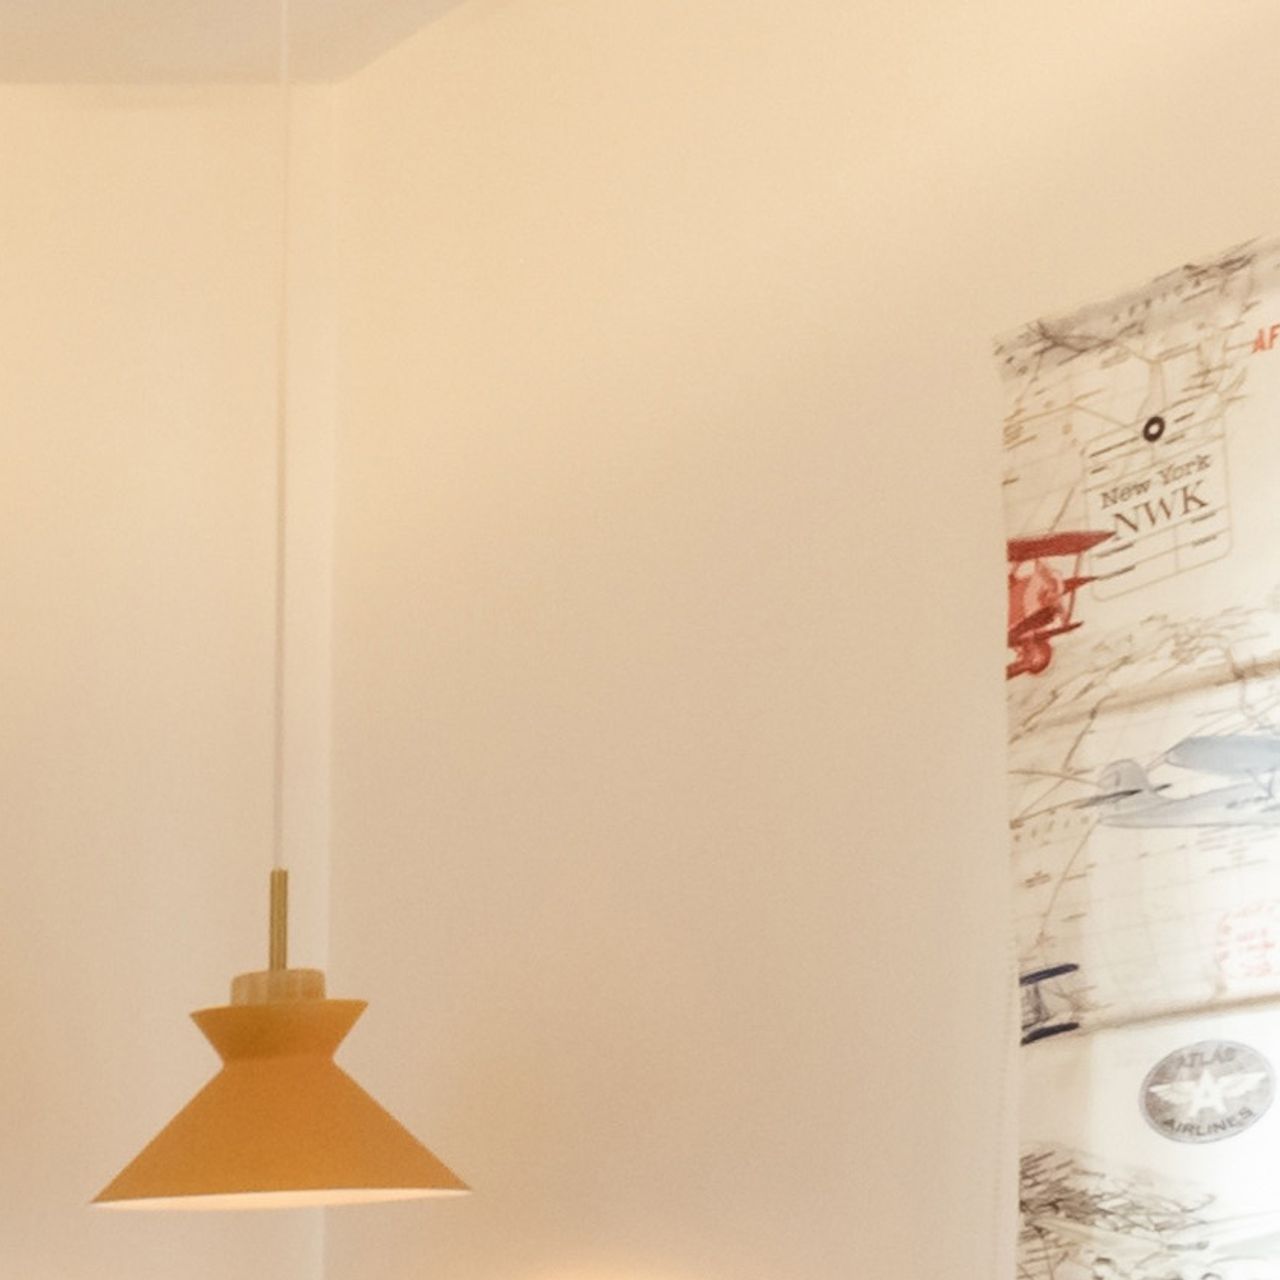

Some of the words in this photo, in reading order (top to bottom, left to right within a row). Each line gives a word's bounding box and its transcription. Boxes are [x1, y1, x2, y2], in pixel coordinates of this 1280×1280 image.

[1100, 479, 1152, 510] New
[1158, 454, 1212, 485] York
[1113, 480, 1209, 541] NWK
[1160, 1106, 1254, 1136] AIRLINES
